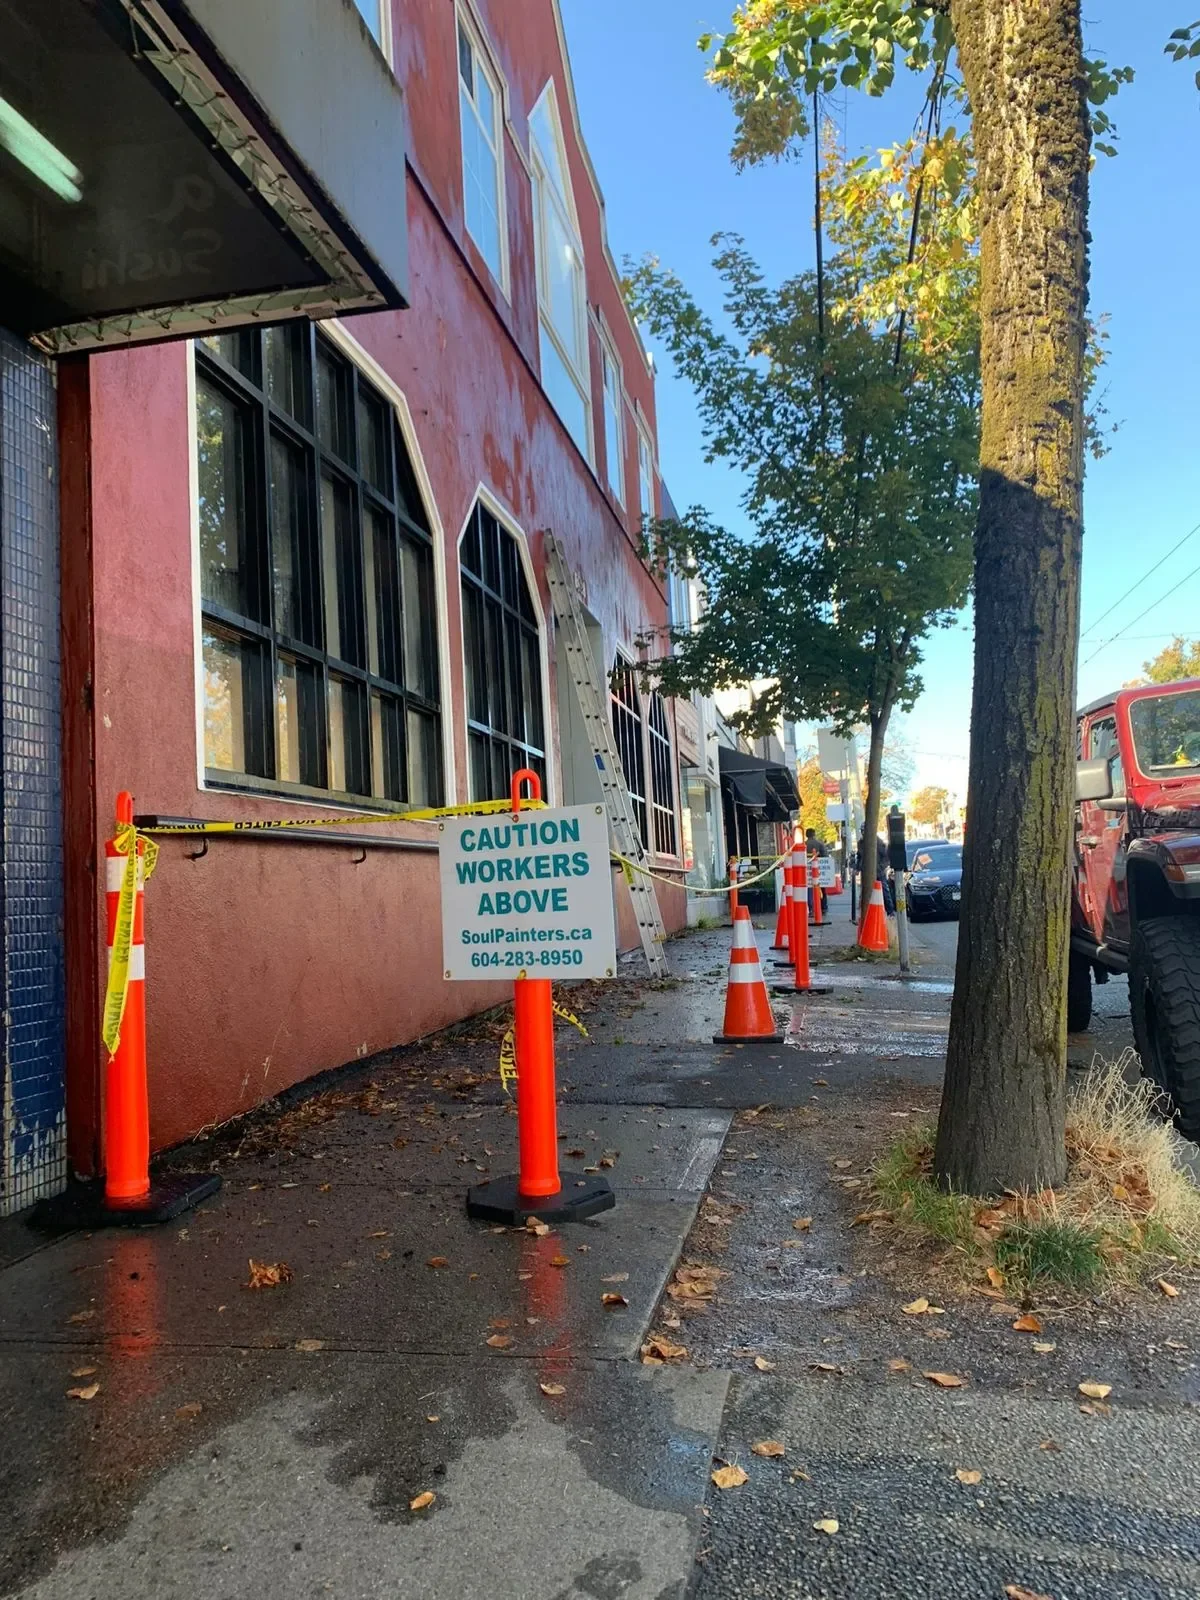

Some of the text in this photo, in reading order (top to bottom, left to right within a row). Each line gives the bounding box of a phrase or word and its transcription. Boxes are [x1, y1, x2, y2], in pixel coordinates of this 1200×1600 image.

[460, 818, 580, 852] CAUTION
[456, 852, 590, 885] WORKERS
[477, 888, 569, 916] ABOVE
[461, 928, 592, 945] SoulPainters.ca
[471, 950, 583, 967] 604-283-8950
[501, 1040, 517, 1079] ENTE
